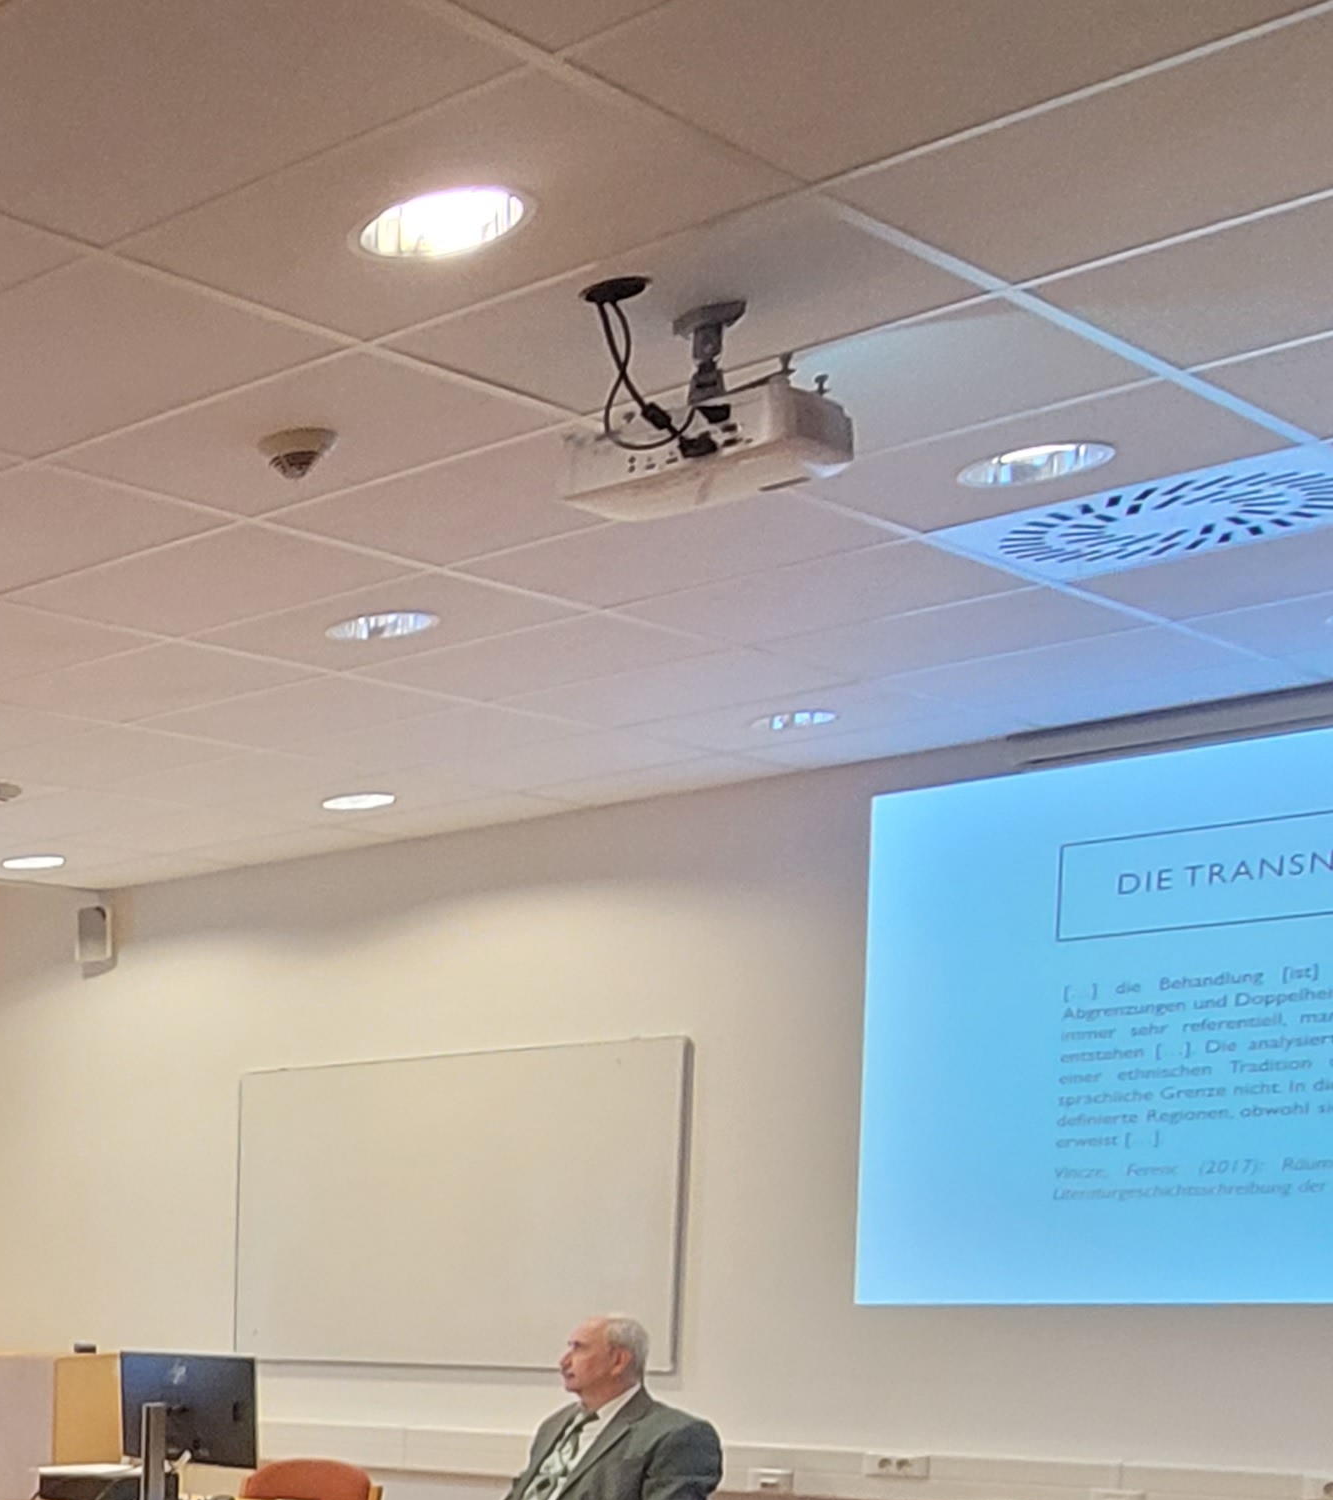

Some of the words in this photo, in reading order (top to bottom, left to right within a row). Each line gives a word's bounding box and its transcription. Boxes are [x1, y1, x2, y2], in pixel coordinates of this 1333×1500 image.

[1117, 868, 1173, 895] DIE
[1116, 981, 1141, 996] die
[1159, 970, 1264, 991] Behandlung
[1282, 963, 1319, 984] [ist]
[1063, 1001, 1186, 1022] Abgrenzungen
[1193, 996, 1227, 1011] und
[1061, 1029, 1117, 1043] immer
[1131, 1023, 1169, 1038] sehr
[1060, 1047, 1145, 1064] entstehen
[1205, 1038, 1237, 1054] Die
[1058, 1072, 1103, 1086] einer
[1117, 1064, 1213, 1082] ethnischen
[1230, 1057, 1313, 1074] Tradition
[1058, 1090, 1154, 1108] sprachliche
[1160, 1086, 1227, 1100] Grenze
[1289, 1080, 1307, 1094] In
[1056, 1109, 1139, 1128] definierte
[1240, 1102, 1310, 1119] obwohl
[1055, 1134, 1119, 1149] erweist
[1127, 1162, 1179, 1177] Ferenc
[1298, 1178, 1326, 1193] der
